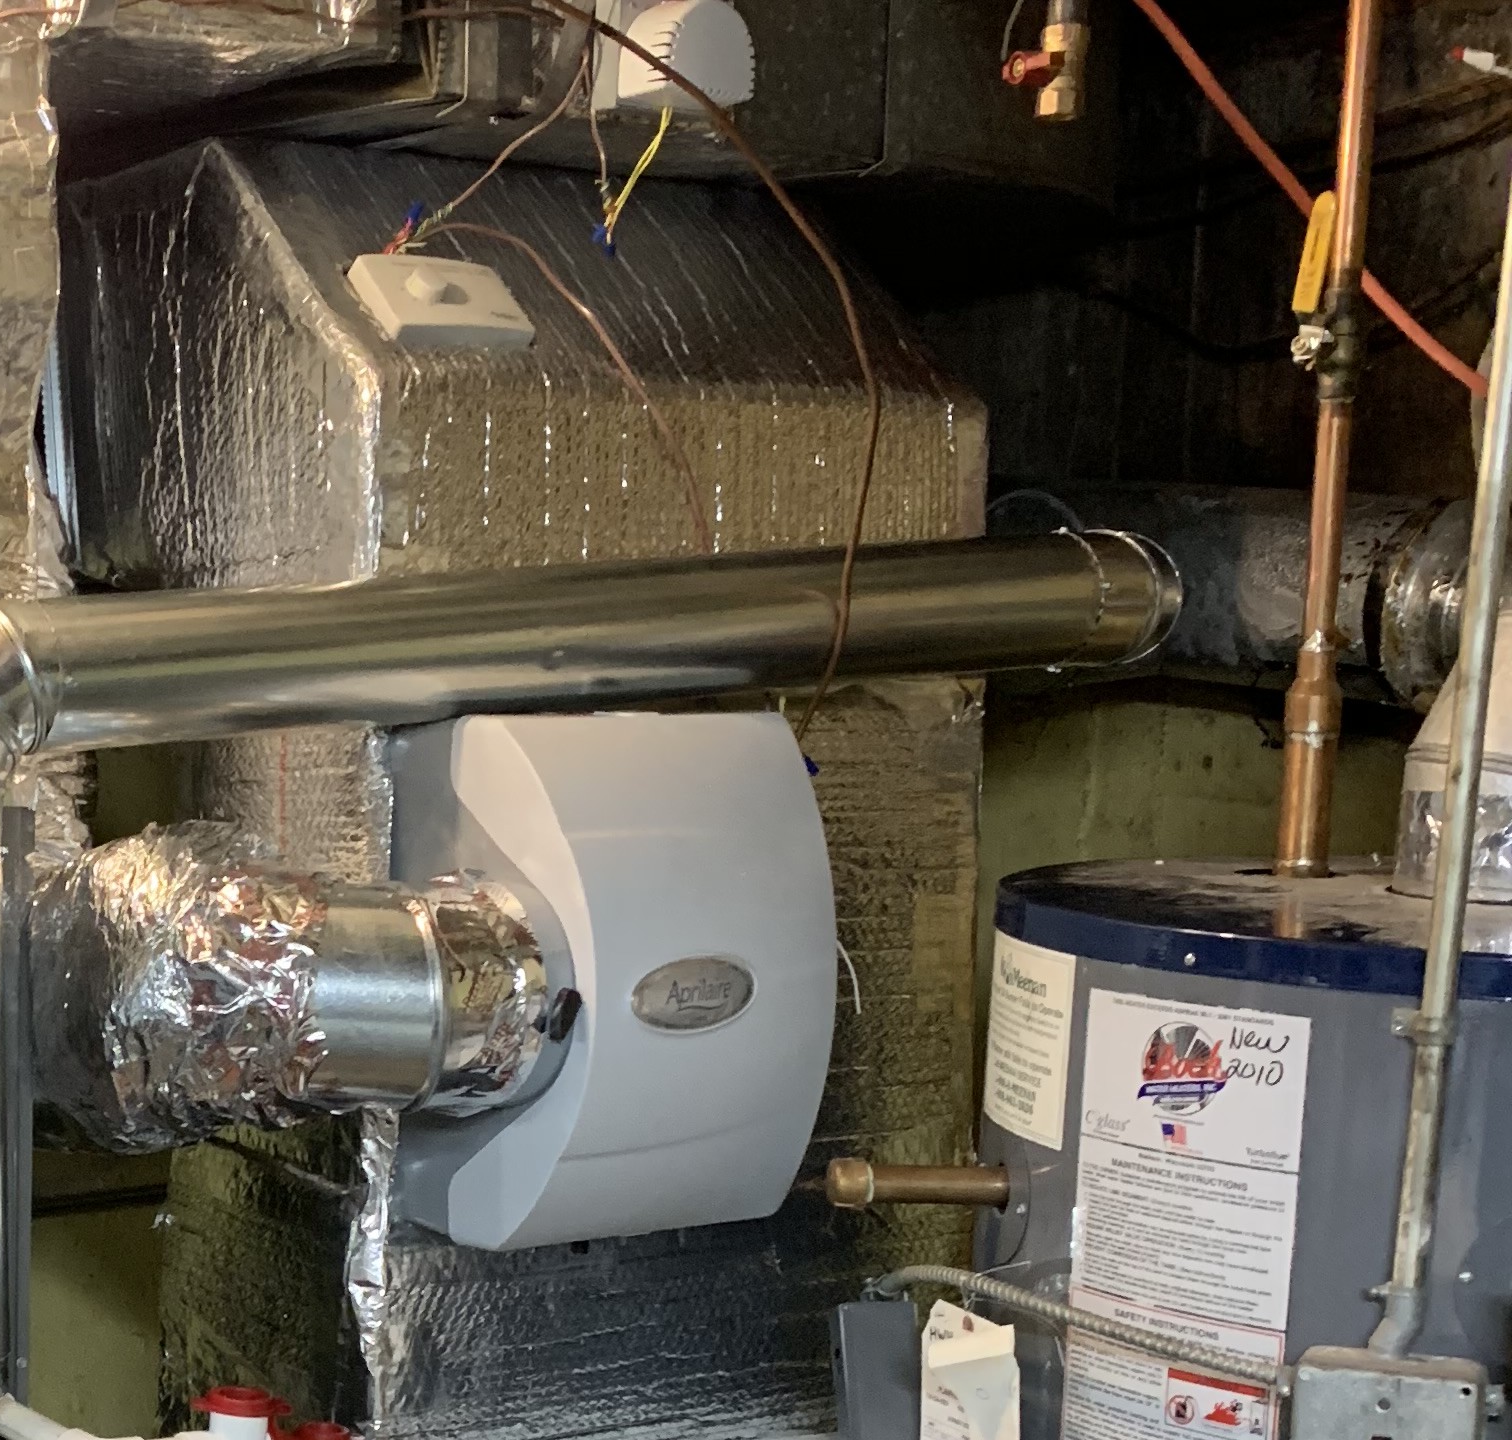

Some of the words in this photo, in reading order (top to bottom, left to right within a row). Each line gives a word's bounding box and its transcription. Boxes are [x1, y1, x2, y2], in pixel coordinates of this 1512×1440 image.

[665, 978, 731, 1012] Aprilaire
[1229, 1026, 1290, 1054] New
[1226, 1057, 1285, 1087] 2010
[1111, 1158, 1172, 1179] MAINTENANCE
[1174, 1169, 1248, 1191] INSTRUCTIONS
[1114, 1308, 1146, 1324] SAFETY
[1148, 1315, 1219, 1341] INSTRUCTIONS
